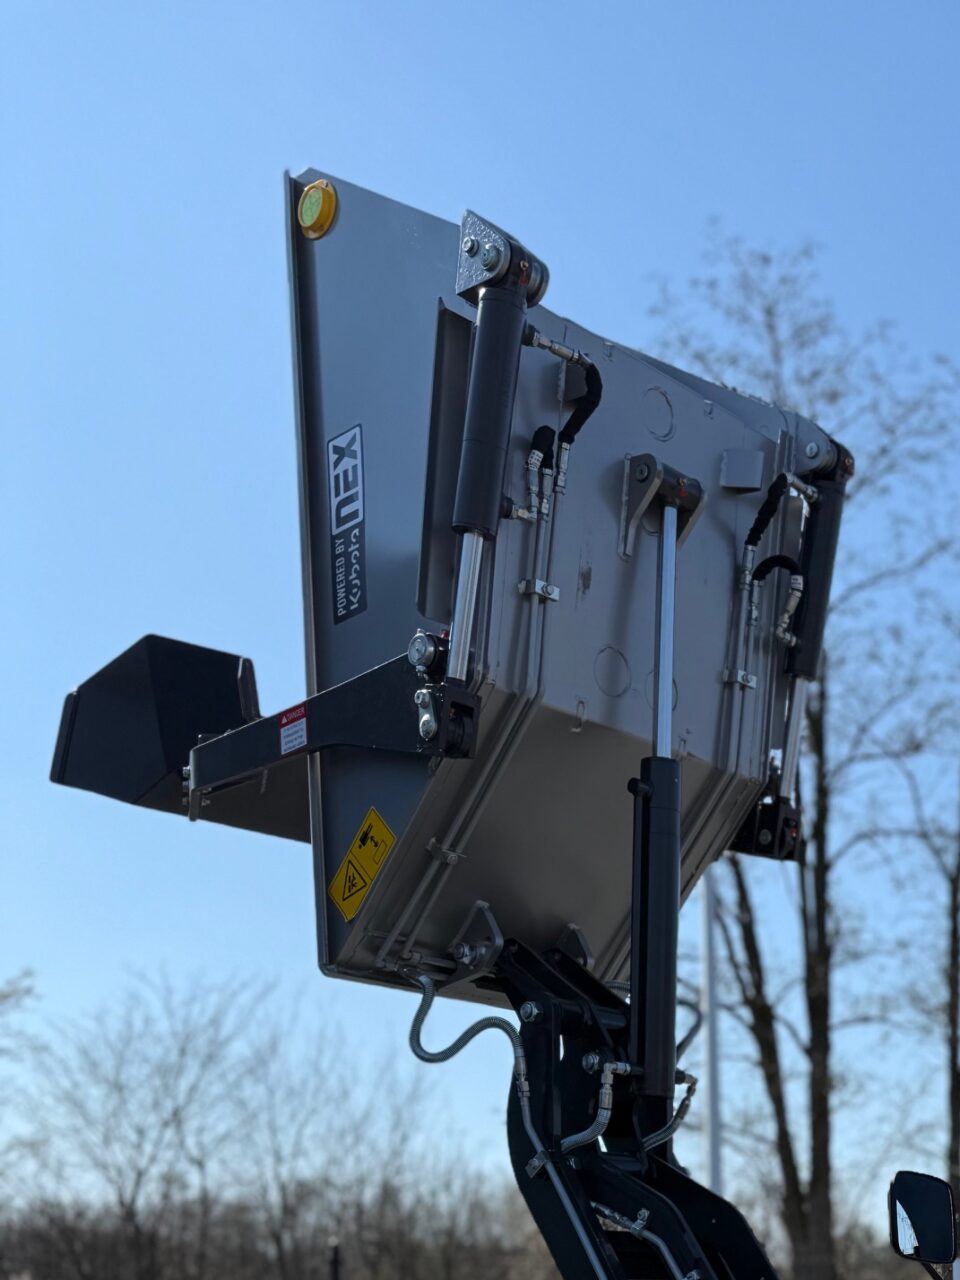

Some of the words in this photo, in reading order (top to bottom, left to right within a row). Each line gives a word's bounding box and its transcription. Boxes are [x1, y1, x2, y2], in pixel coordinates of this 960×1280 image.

[335, 538, 345, 555] BY
[348, 528, 361, 610] Kubota
[335, 556, 346, 617] POWERED
